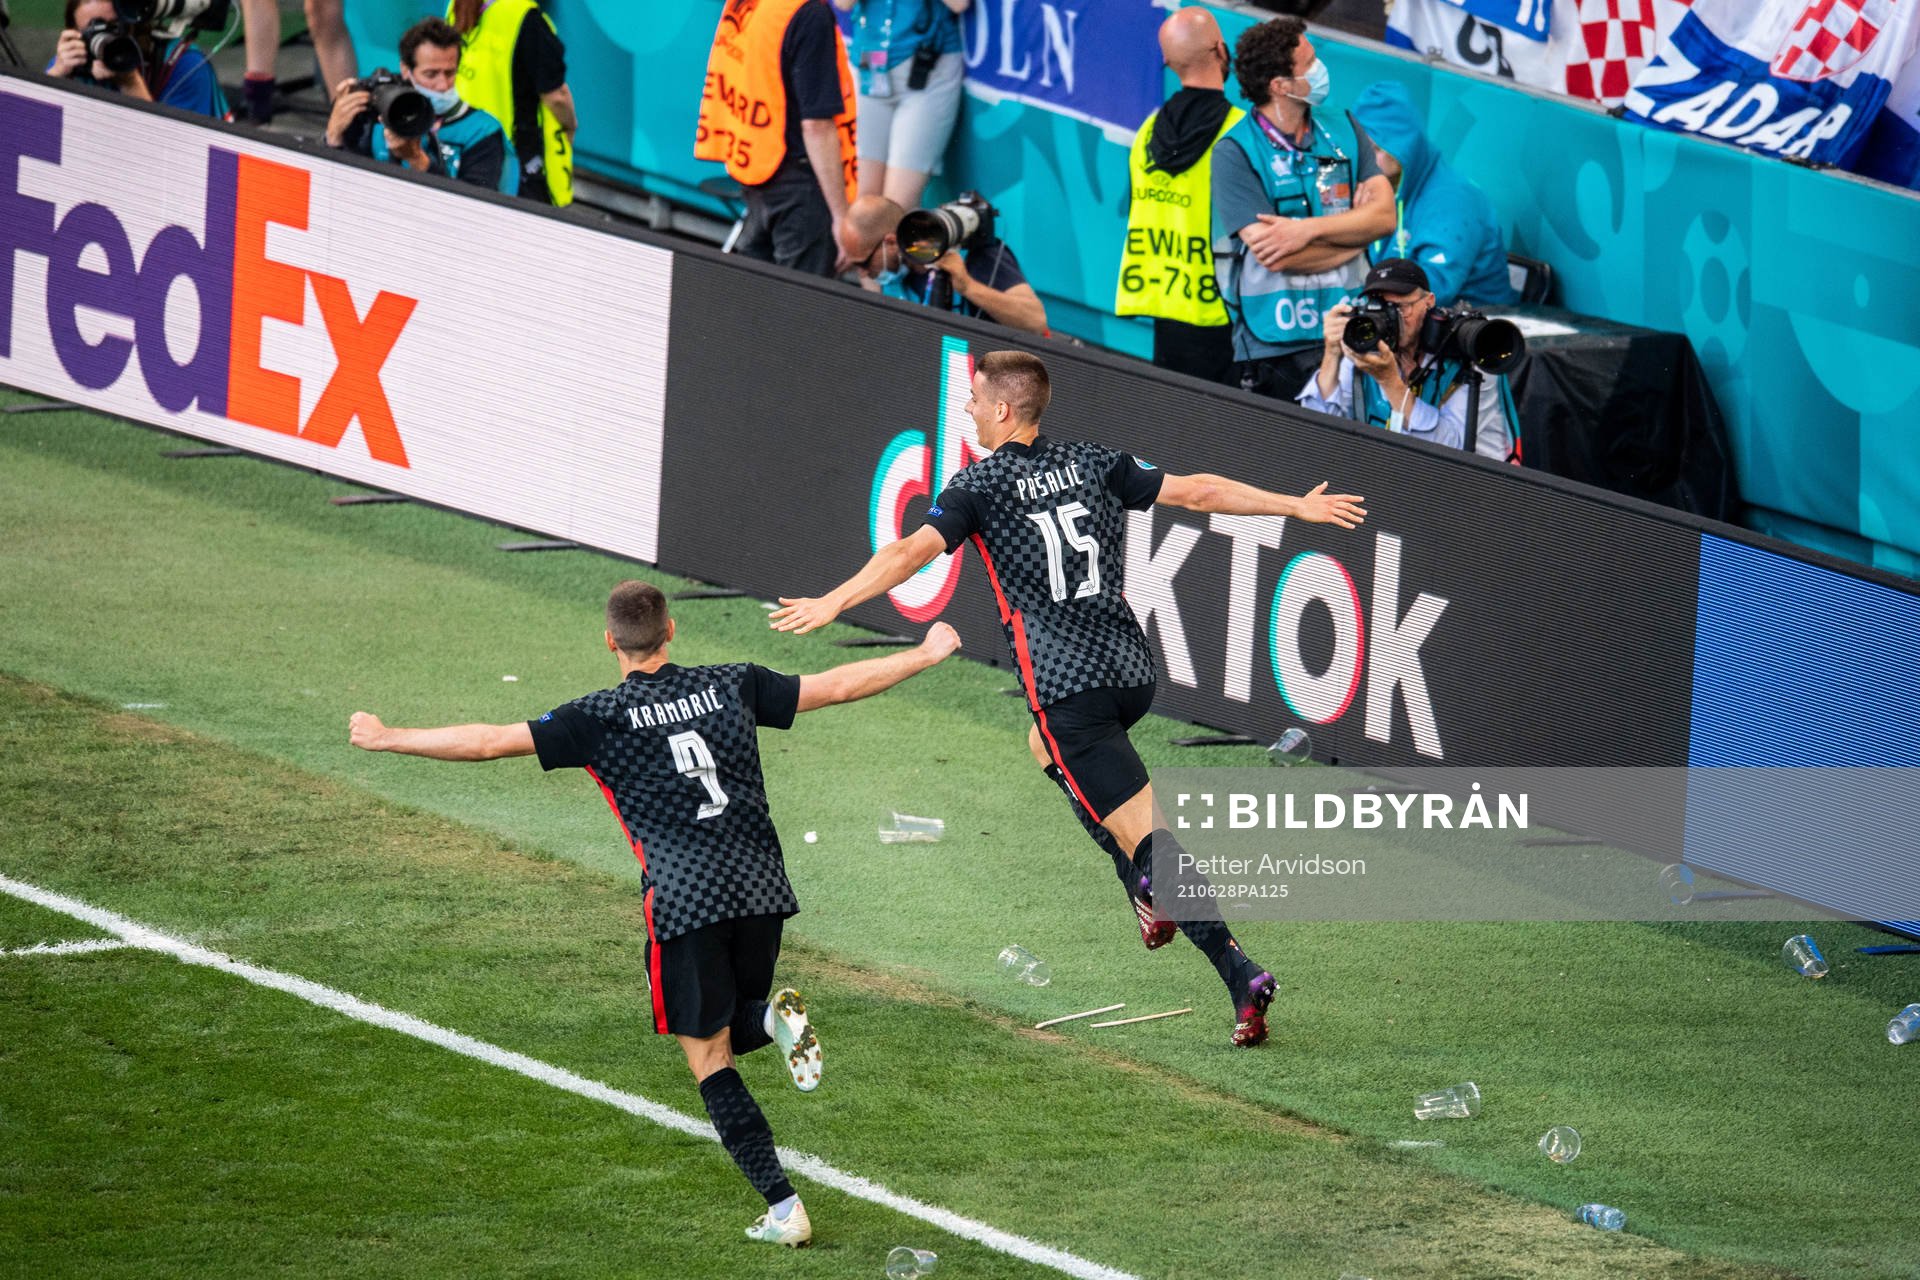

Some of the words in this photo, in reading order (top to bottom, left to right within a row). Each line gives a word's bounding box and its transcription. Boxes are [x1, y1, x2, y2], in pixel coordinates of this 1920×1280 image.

[1625, 42, 1852, 158] ZADAR
[0, 90, 418, 469] FedEx
[1016, 460, 1084, 501] PAŠALIĆ
[1026, 501, 1100, 602] 15
[628, 685, 724, 729] KRAMARIĆ
[667, 730, 729, 820] 9
